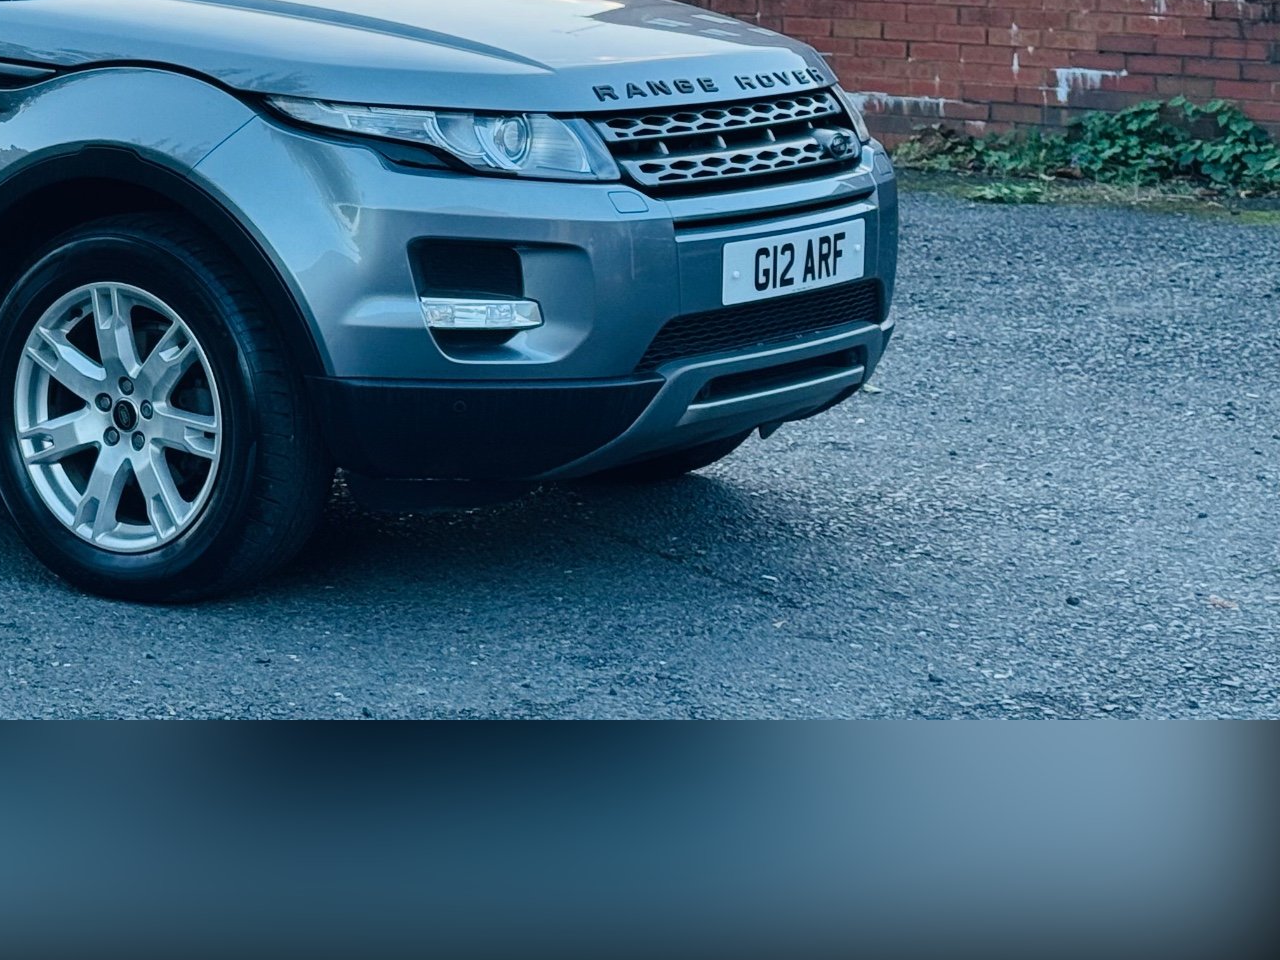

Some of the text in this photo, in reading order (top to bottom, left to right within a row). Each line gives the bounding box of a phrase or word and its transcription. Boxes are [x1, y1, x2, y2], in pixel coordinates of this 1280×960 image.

[592, 67, 824, 102] RANGE ROVER
[754, 232, 846, 291] G12 ARF
